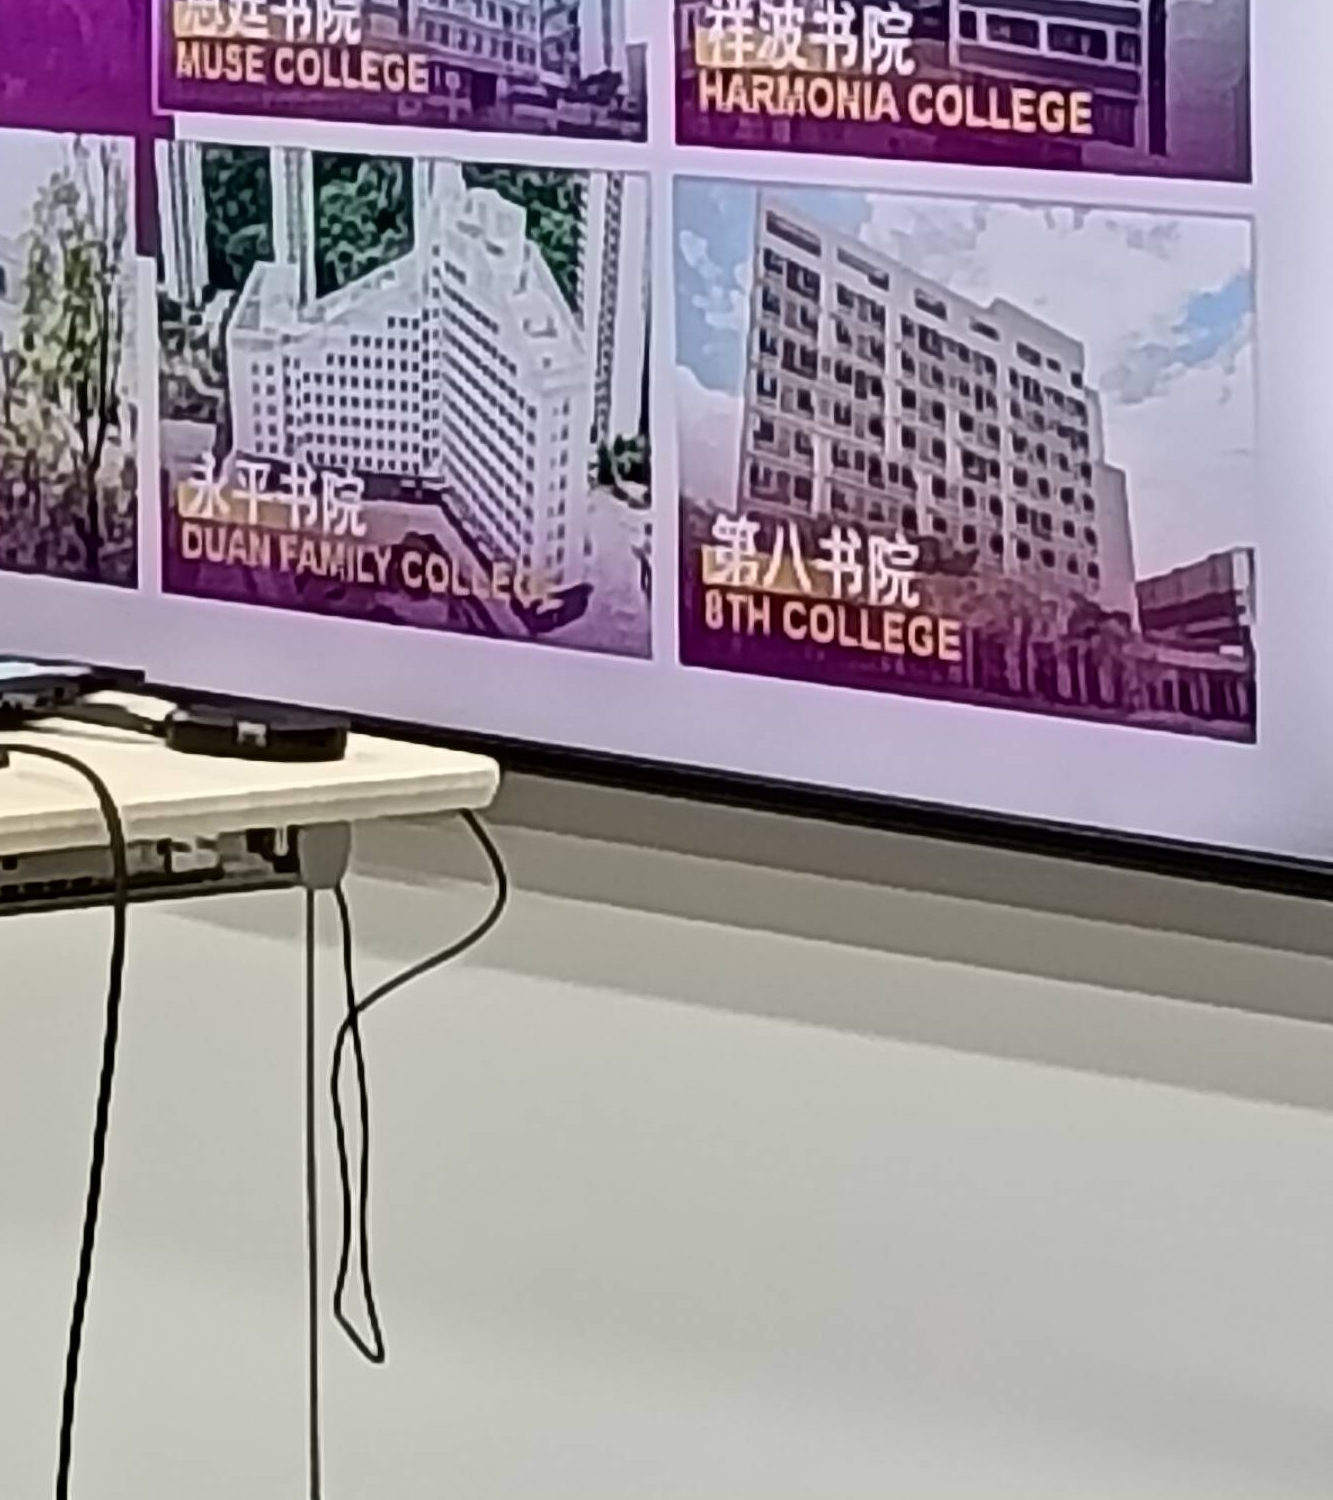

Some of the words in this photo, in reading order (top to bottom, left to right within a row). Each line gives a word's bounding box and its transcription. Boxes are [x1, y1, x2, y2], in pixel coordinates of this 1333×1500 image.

[176, 41, 268, 85] MUSE
[273, 46, 431, 93] COLLEGE
[698, 68, 900, 122] HARMONIA
[907, 83, 1094, 136] COLLEGE
[188, 451, 367, 537] 永平书院
[181, 522, 271, 568] DUAN
[278, 534, 393, 587] FAMILY
[401, 551, 560, 611] COLLEG
[711, 512, 921, 608] 第八书院
[703, 588, 772, 638] 8TH
[782, 599, 963, 663] COLLEGE
